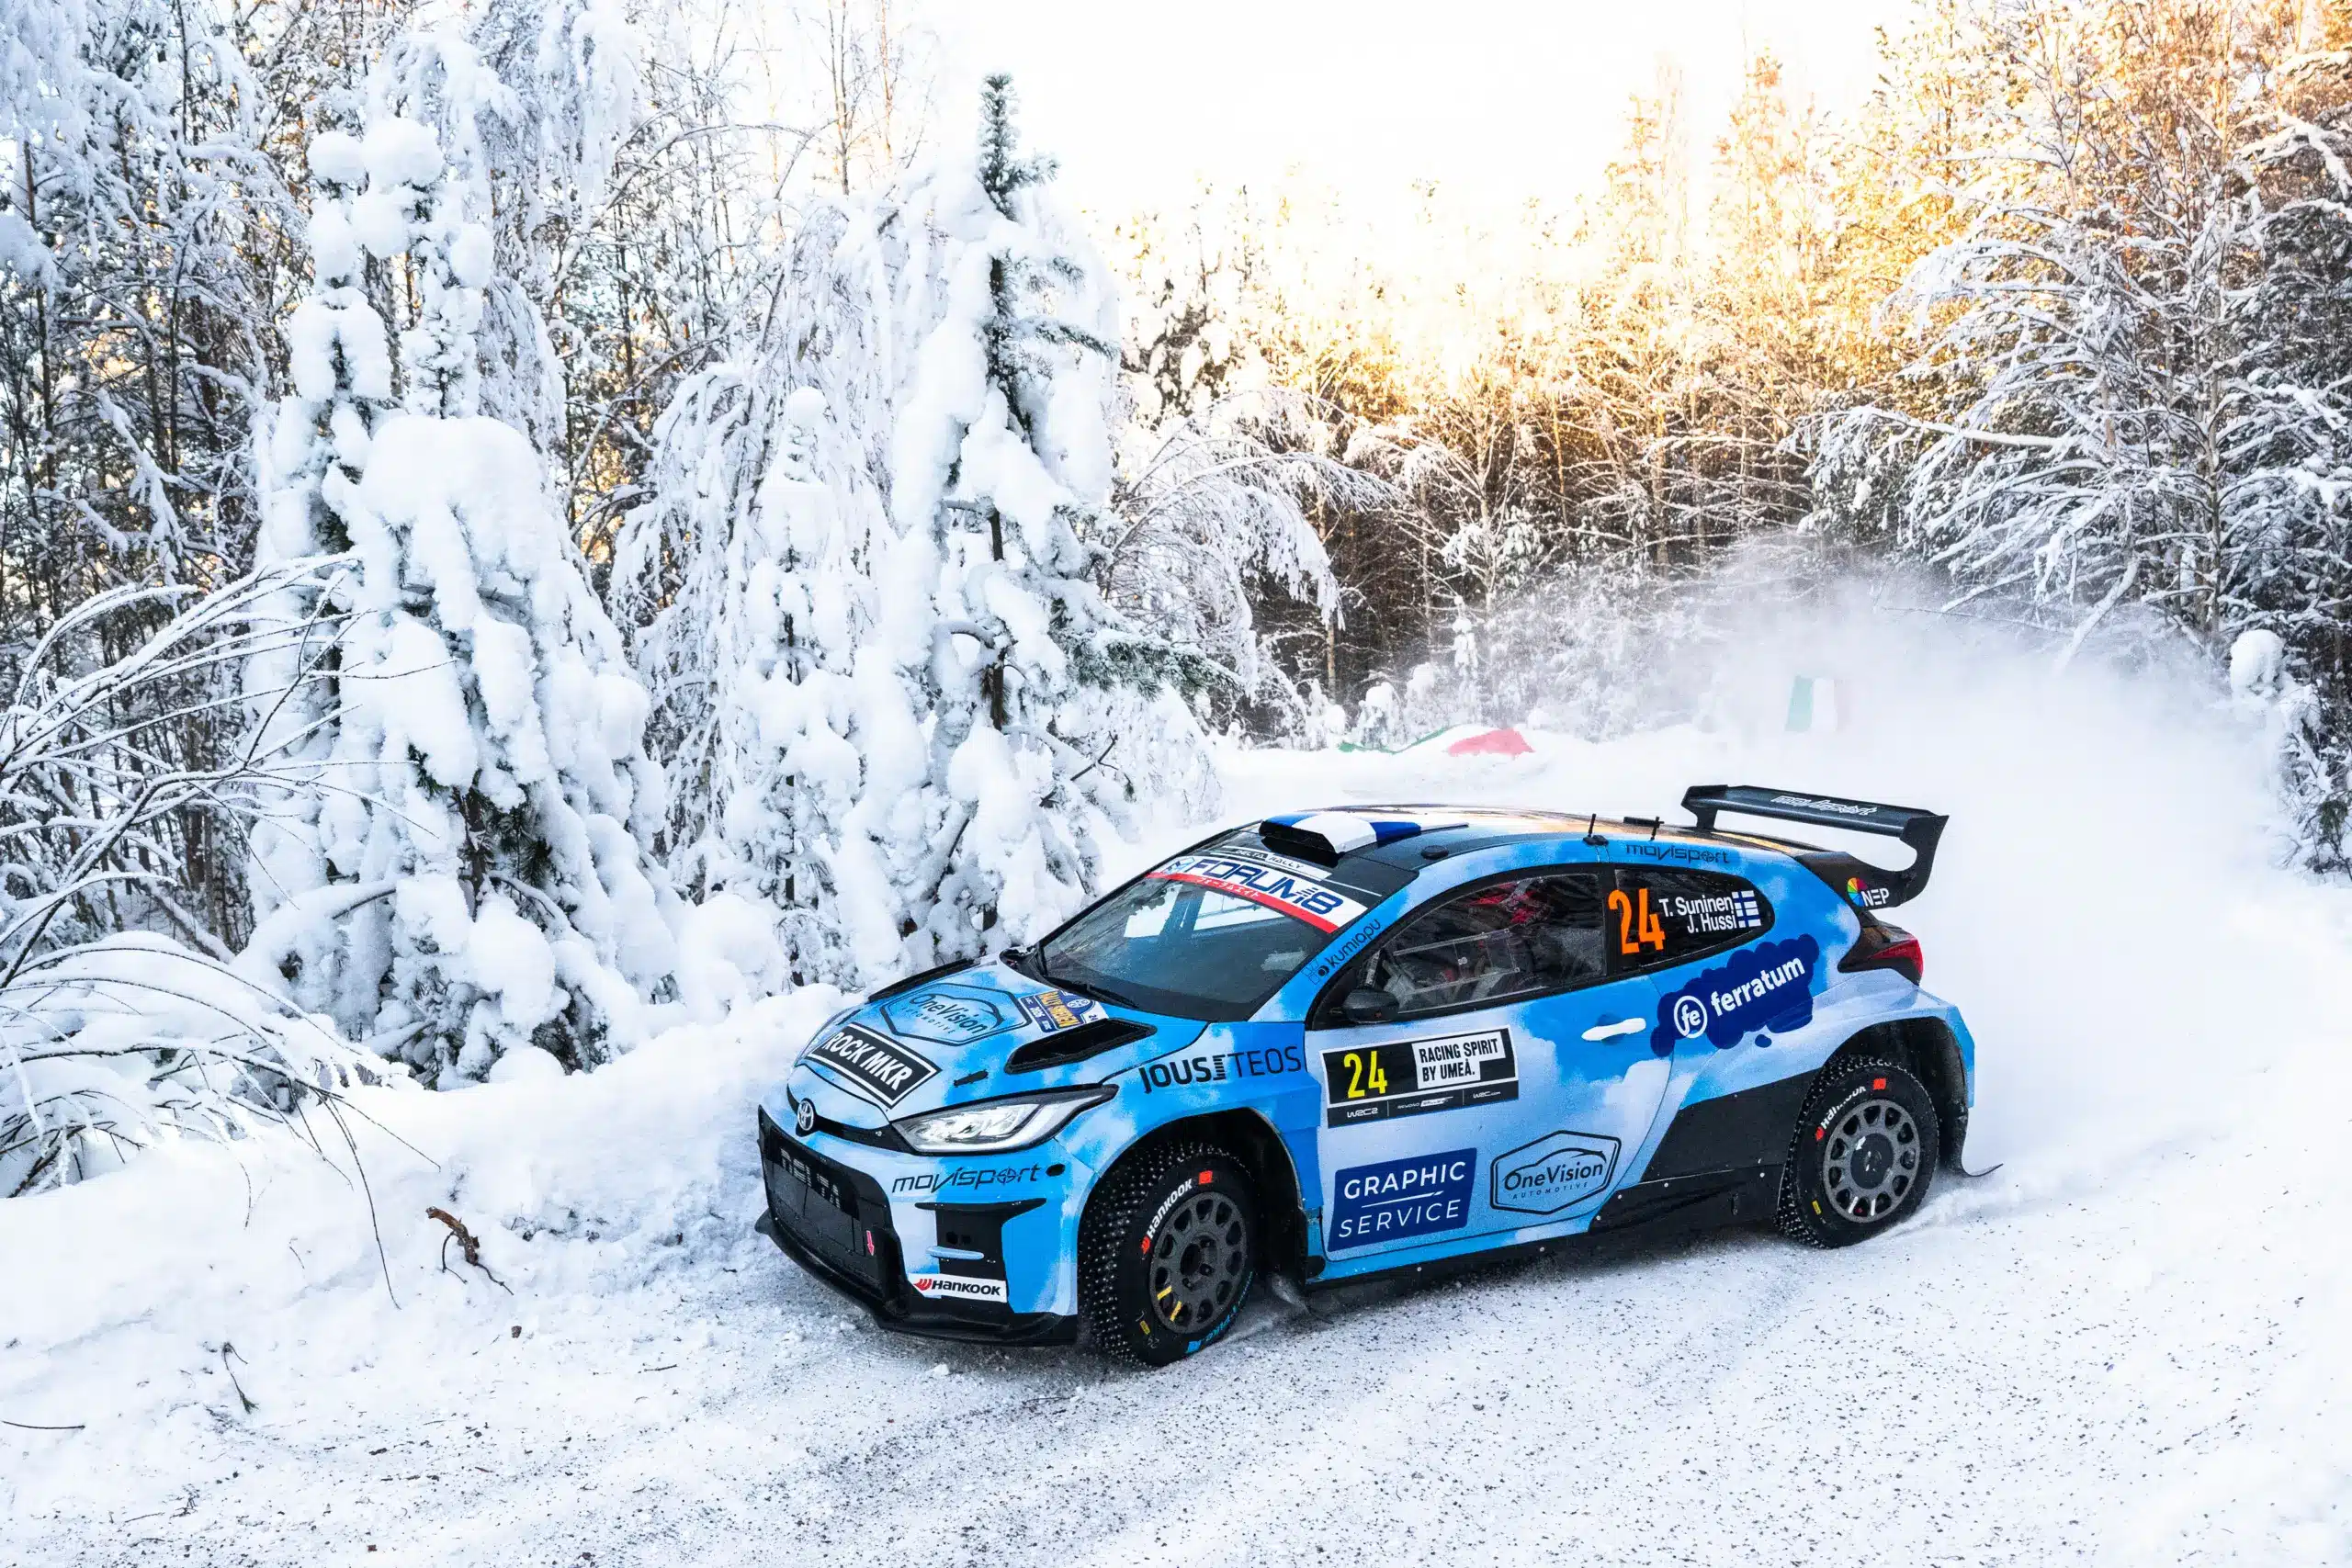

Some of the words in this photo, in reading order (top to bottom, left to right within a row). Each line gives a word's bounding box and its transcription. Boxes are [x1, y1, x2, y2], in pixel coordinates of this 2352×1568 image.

[1269, 855, 1304, 868] RALLY
[1626, 844, 1730, 863] movisport
[1183, 859, 1344, 915] FORUM8
[1860, 887, 1890, 907] NEP
[1658, 898, 1673, 917] T.
[1675, 895, 1734, 916] Suninen
[1608, 888, 1666, 955] 24
[1687, 915, 1699, 933] J.
[1700, 912, 1737, 933] Hussi
[1326, 919, 1381, 967] kumiapu
[1711, 957, 1805, 1017] ferratum
[910, 994, 988, 1034] OneVision
[822, 1032, 870, 1065] ROCK
[860, 1051, 913, 1091] MKR
[1419, 1044, 1461, 1063] RACING
[1464, 1038, 1498, 1057] SPIRIT
[1343, 1051, 1388, 1099] 24
[1422, 1065, 1437, 1082] BY
[1440, 1058, 1476, 1080] UMEÅ.
[1346, 1107, 1379, 1118] WRC2
[892, 1163, 1042, 1194] movisport
[1344, 1161, 1465, 1200] GRAPHIC
[1504, 1161, 1603, 1191] OneVision
[1512, 1181, 1588, 1200] AUTOMOTIVE
[1339, 1199, 1461, 1238] SERVICE
